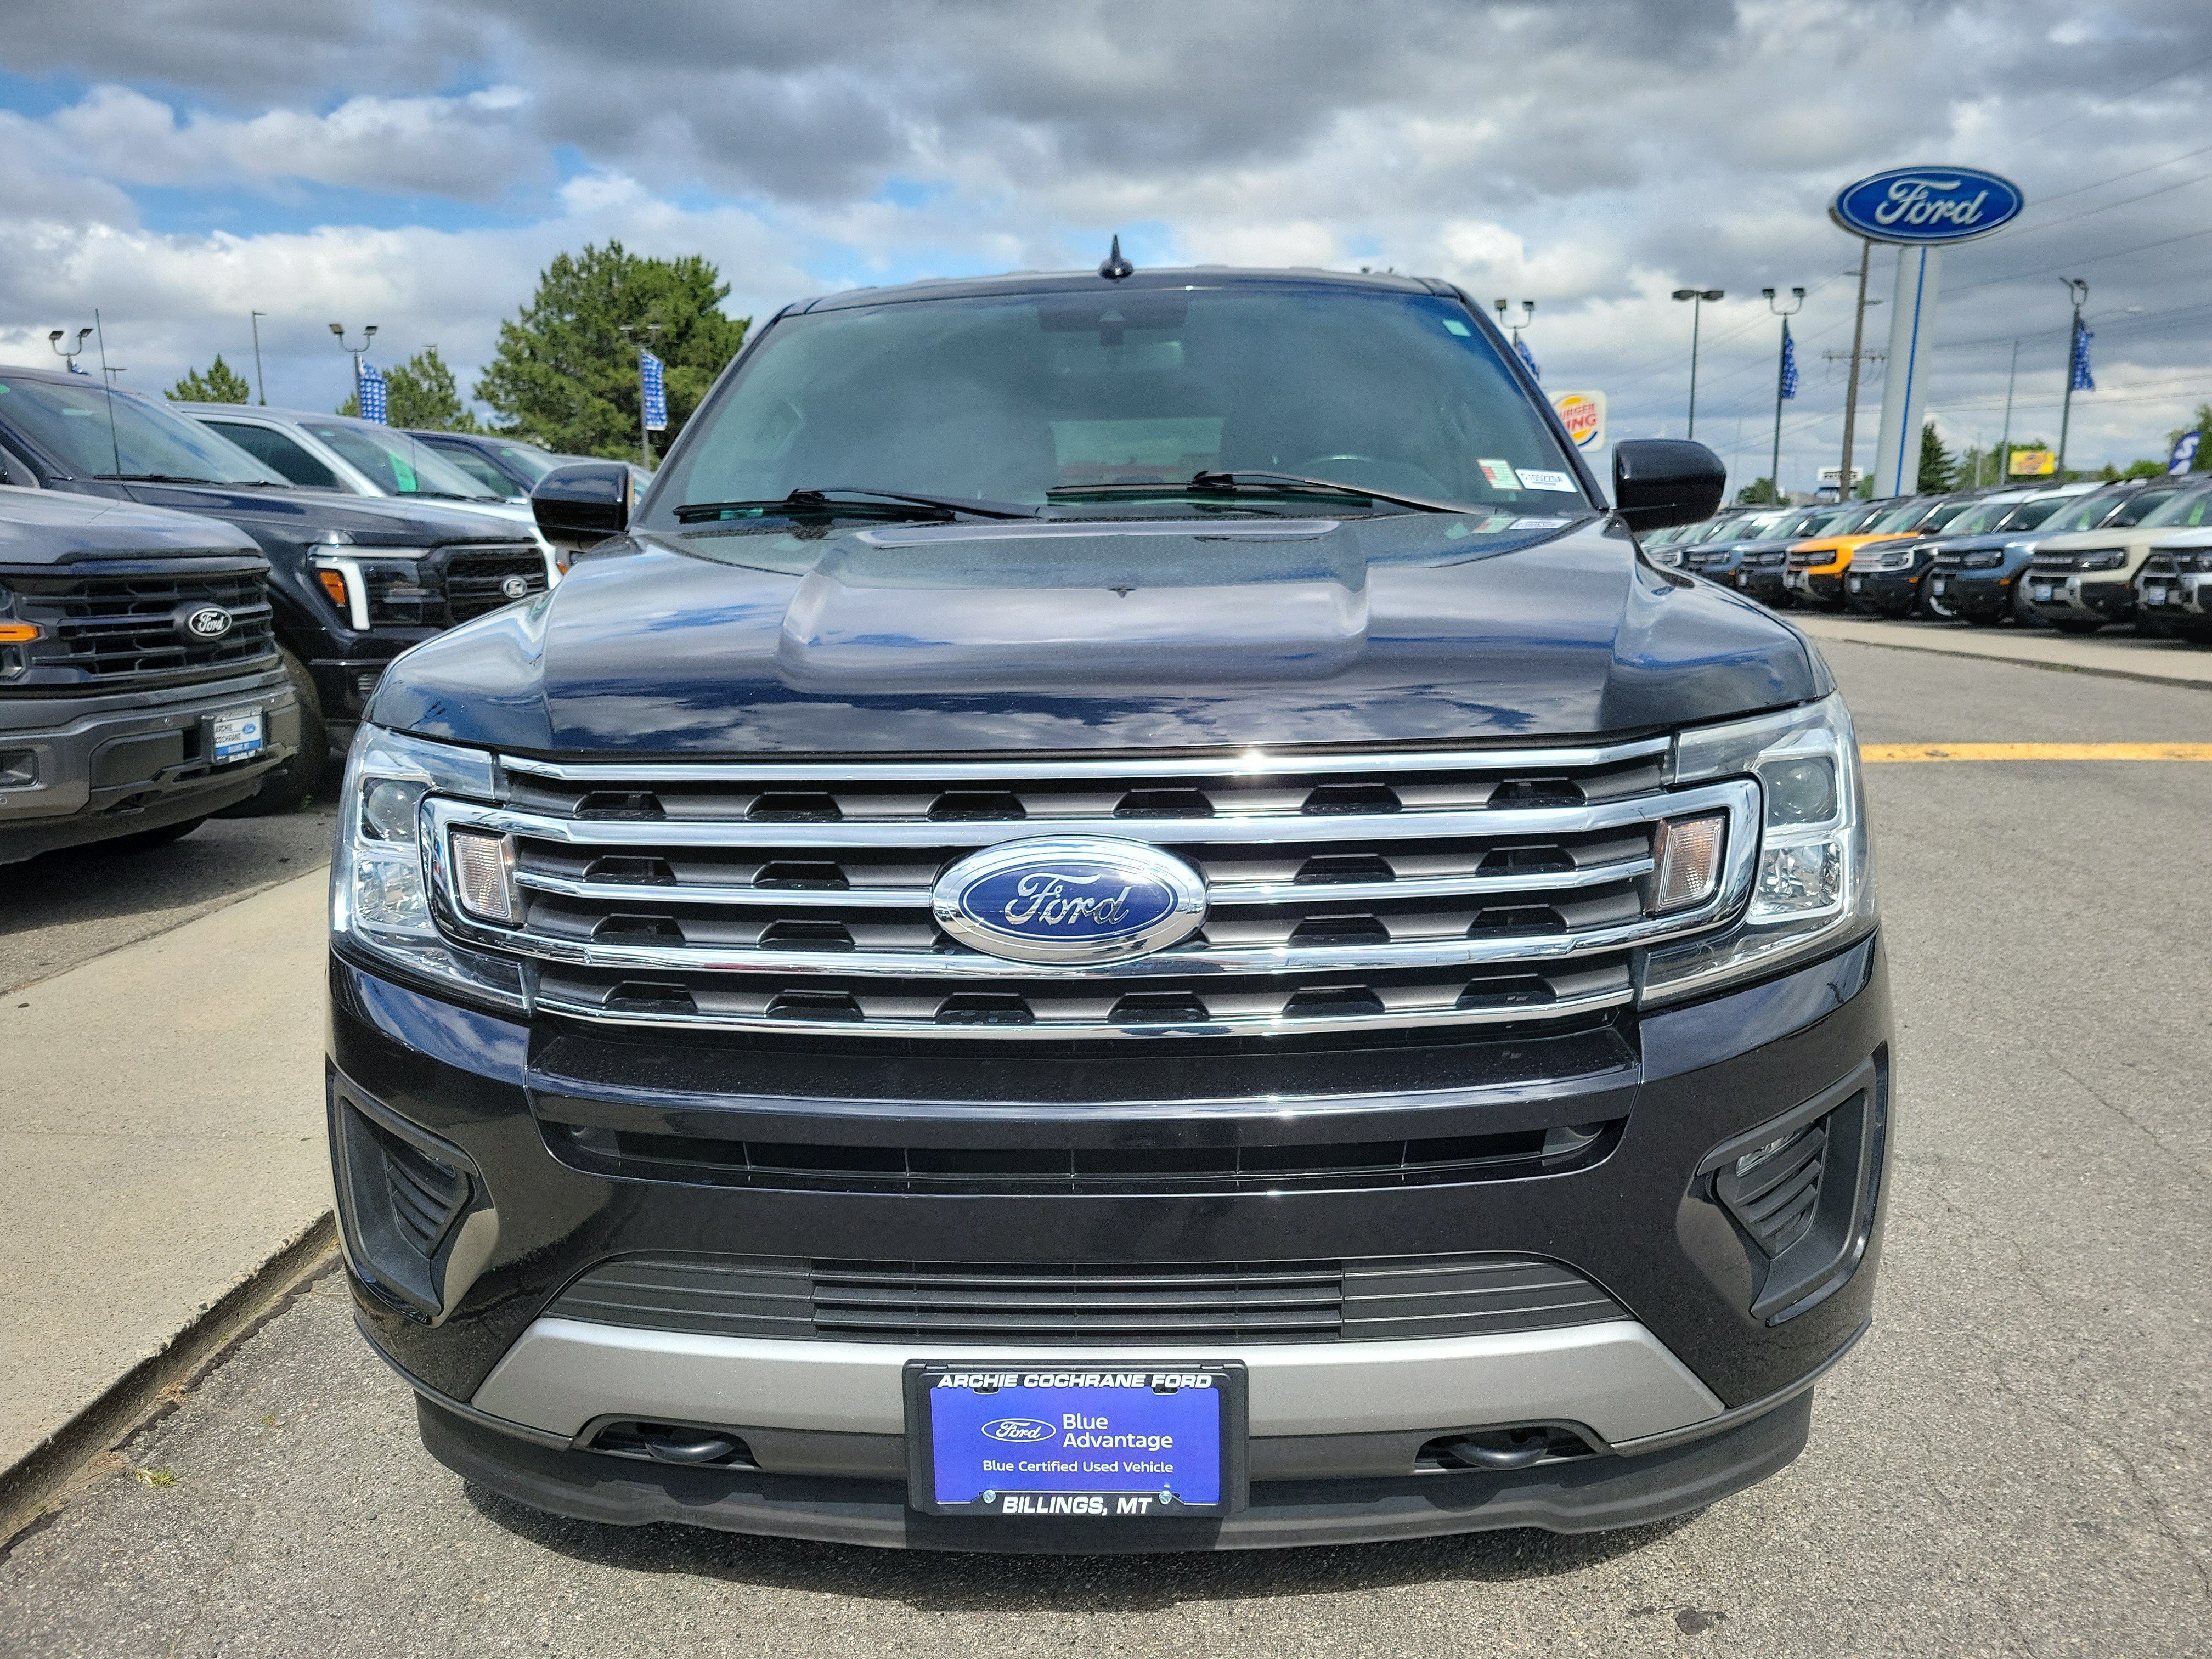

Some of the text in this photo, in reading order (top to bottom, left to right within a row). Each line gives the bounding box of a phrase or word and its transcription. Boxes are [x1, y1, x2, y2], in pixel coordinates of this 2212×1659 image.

[1874, 178, 1989, 225] Ford
[1559, 403, 1595, 419] URGER
[1565, 414, 1596, 430] ING
[198, 612, 225, 632] Ford
[1005, 873, 1131, 925] Ford
[937, 1374, 1212, 1389] ARCHIE COCHRANE FORD
[995, 1421, 1042, 1438] Ford
[1062, 1413, 1108, 1430] Blue
[1062, 1432, 1173, 1451] Advantage
[982, 1460, 1174, 1473] Blue Certified Used Vehicle
[1002, 1496, 1152, 1516] BILLINGS, MT
